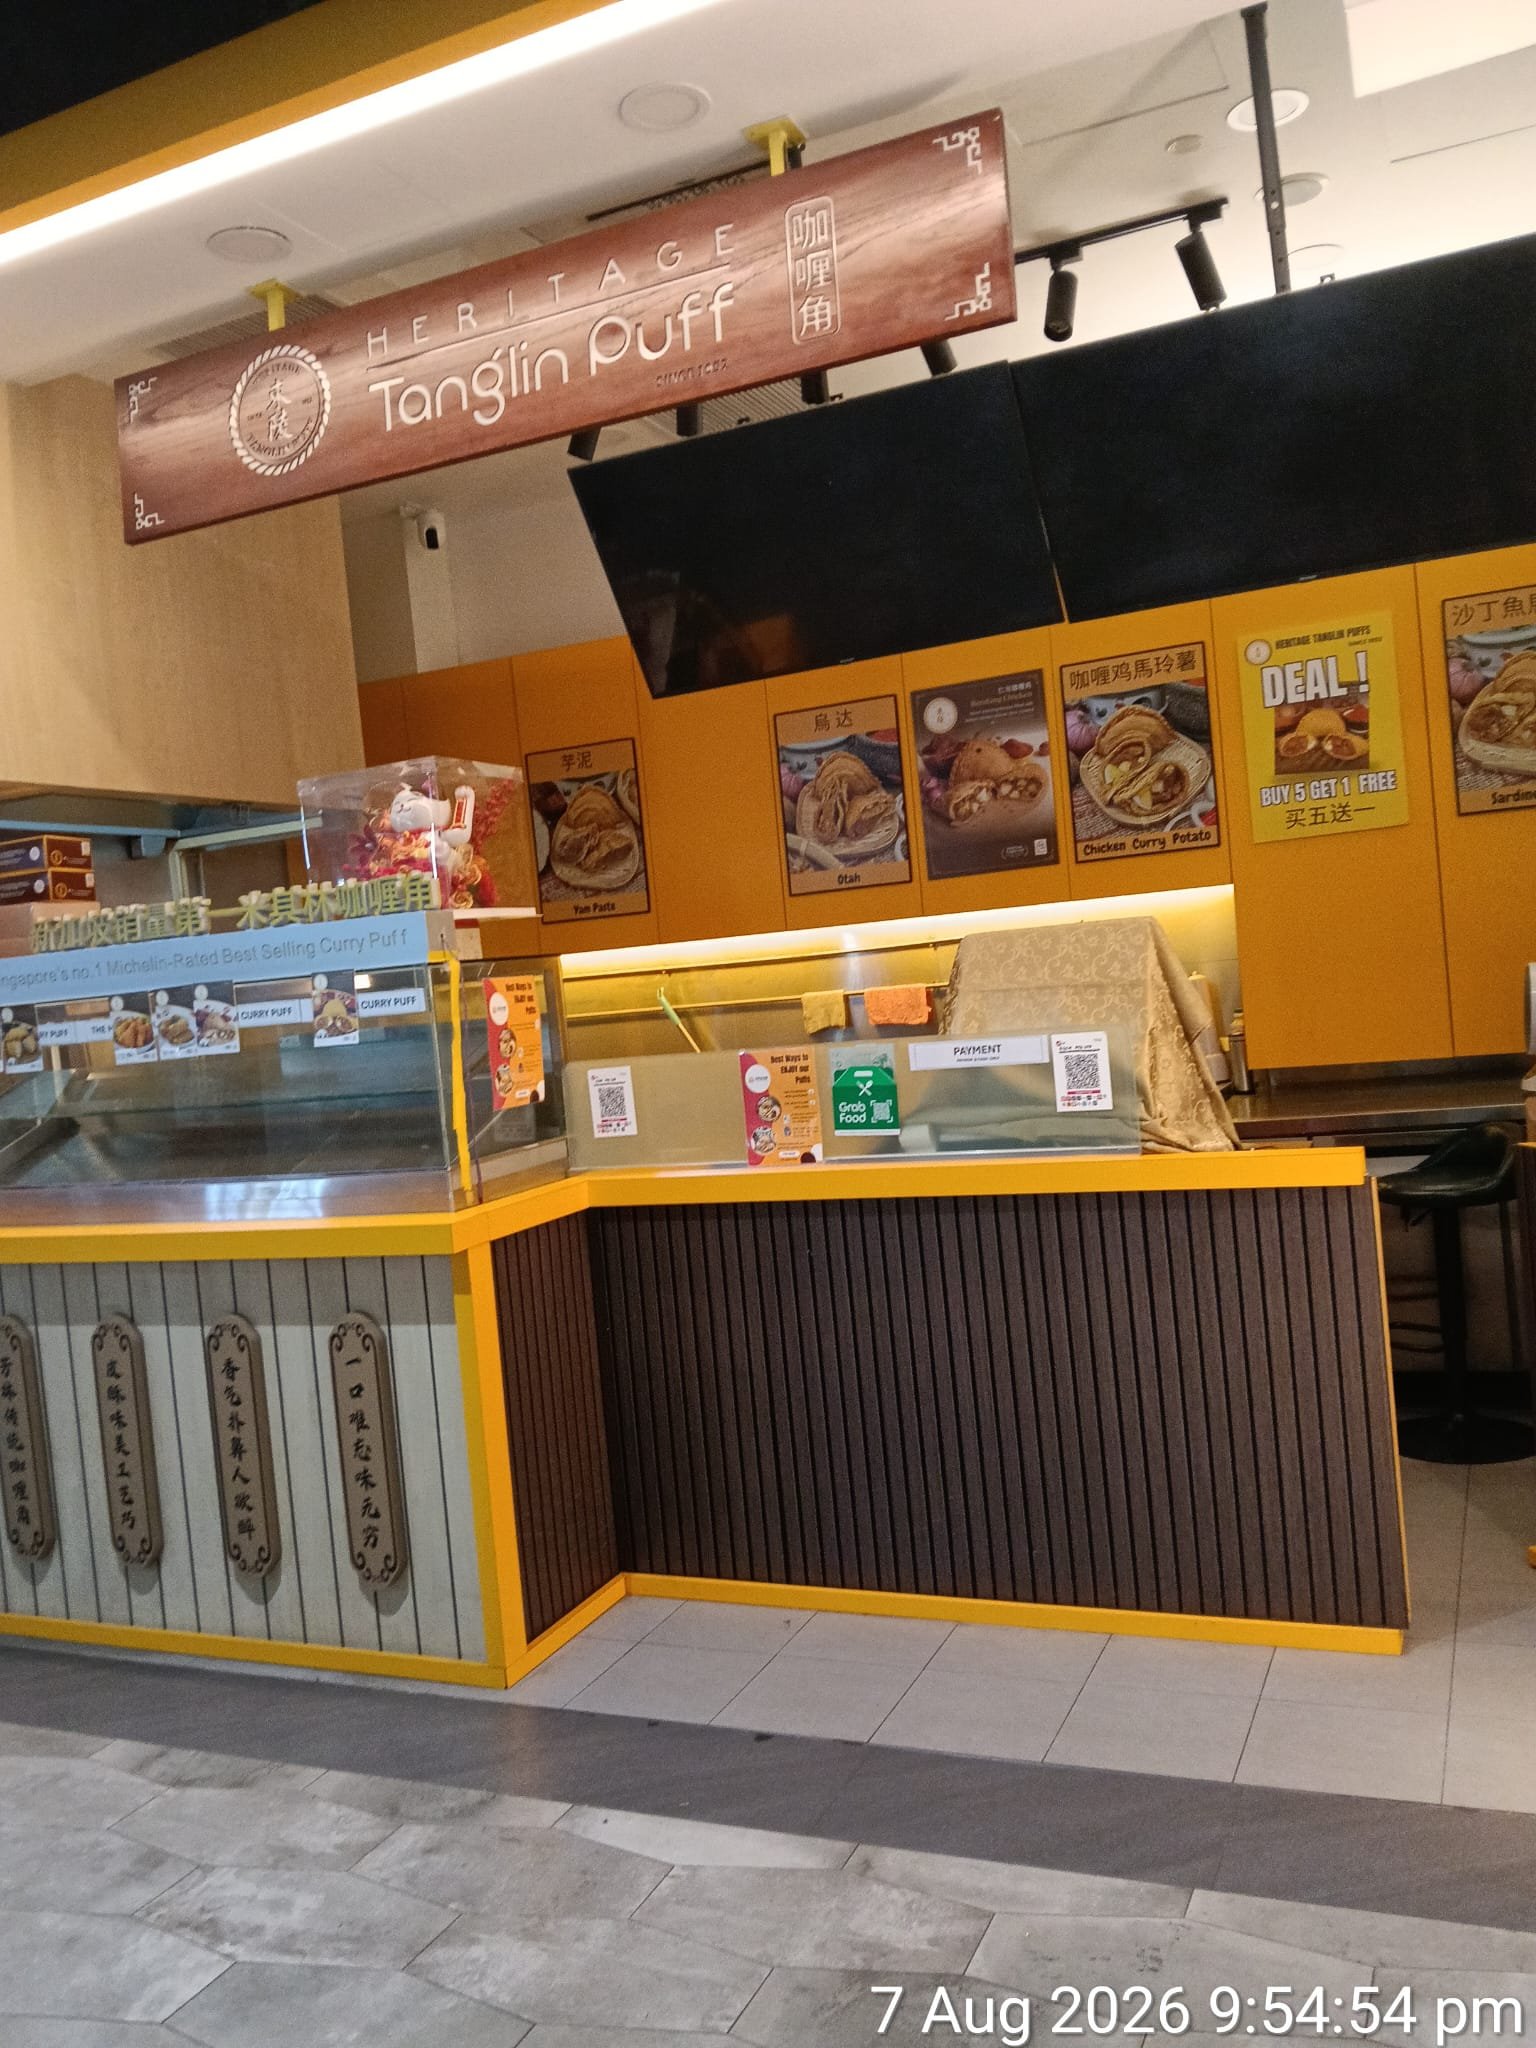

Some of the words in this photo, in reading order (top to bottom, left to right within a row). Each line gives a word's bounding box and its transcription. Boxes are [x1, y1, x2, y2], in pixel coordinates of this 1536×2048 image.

[792, 208, 833, 336] 咖喱角
[366, 224, 734, 359] HERITAGE
[368, 341, 569, 432] Tanglin
[1275, 634, 1311, 650] HERITAGE
[1313, 628, 1345, 644] TANGLIN
[1346, 625, 1371, 638] PUFFS
[1260, 655, 1348, 708] DEAL
[561, 751, 593, 772] 芋泥
[1259, 784, 1291, 807] BUY
[1294, 782, 1306, 803] 5
[1309, 778, 1338, 800] GET
[1341, 776, 1351, 796] 1
[1357, 769, 1397, 794] FREE
[1285, 801, 1376, 829] 买五送一
[1083, 841, 1126, 856] Chicken
[1132, 838, 1167, 850] Curry
[1172, 829, 1212, 844] Potato
[837, 872, 861, 885] Otah
[573, 904, 591, 915] Yam
[592, 901, 616, 913] Paste
[106, 949, 219, 976] Michelin-Rated
[223, 944, 257, 964] Best
[261, 940, 316, 960] Selling
[319, 935, 364, 954] Curry
[240, 1007, 269, 1020] CURRY
[271, 1006, 292, 1018] PUFF
[361, 998, 392, 1010] CURRY
[393, 995, 417, 1007] PUFF
[953, 1044, 1002, 1056] PAYMENT
[838, 1101, 866, 1113] Grab
[839, 1112, 867, 1124] Food
